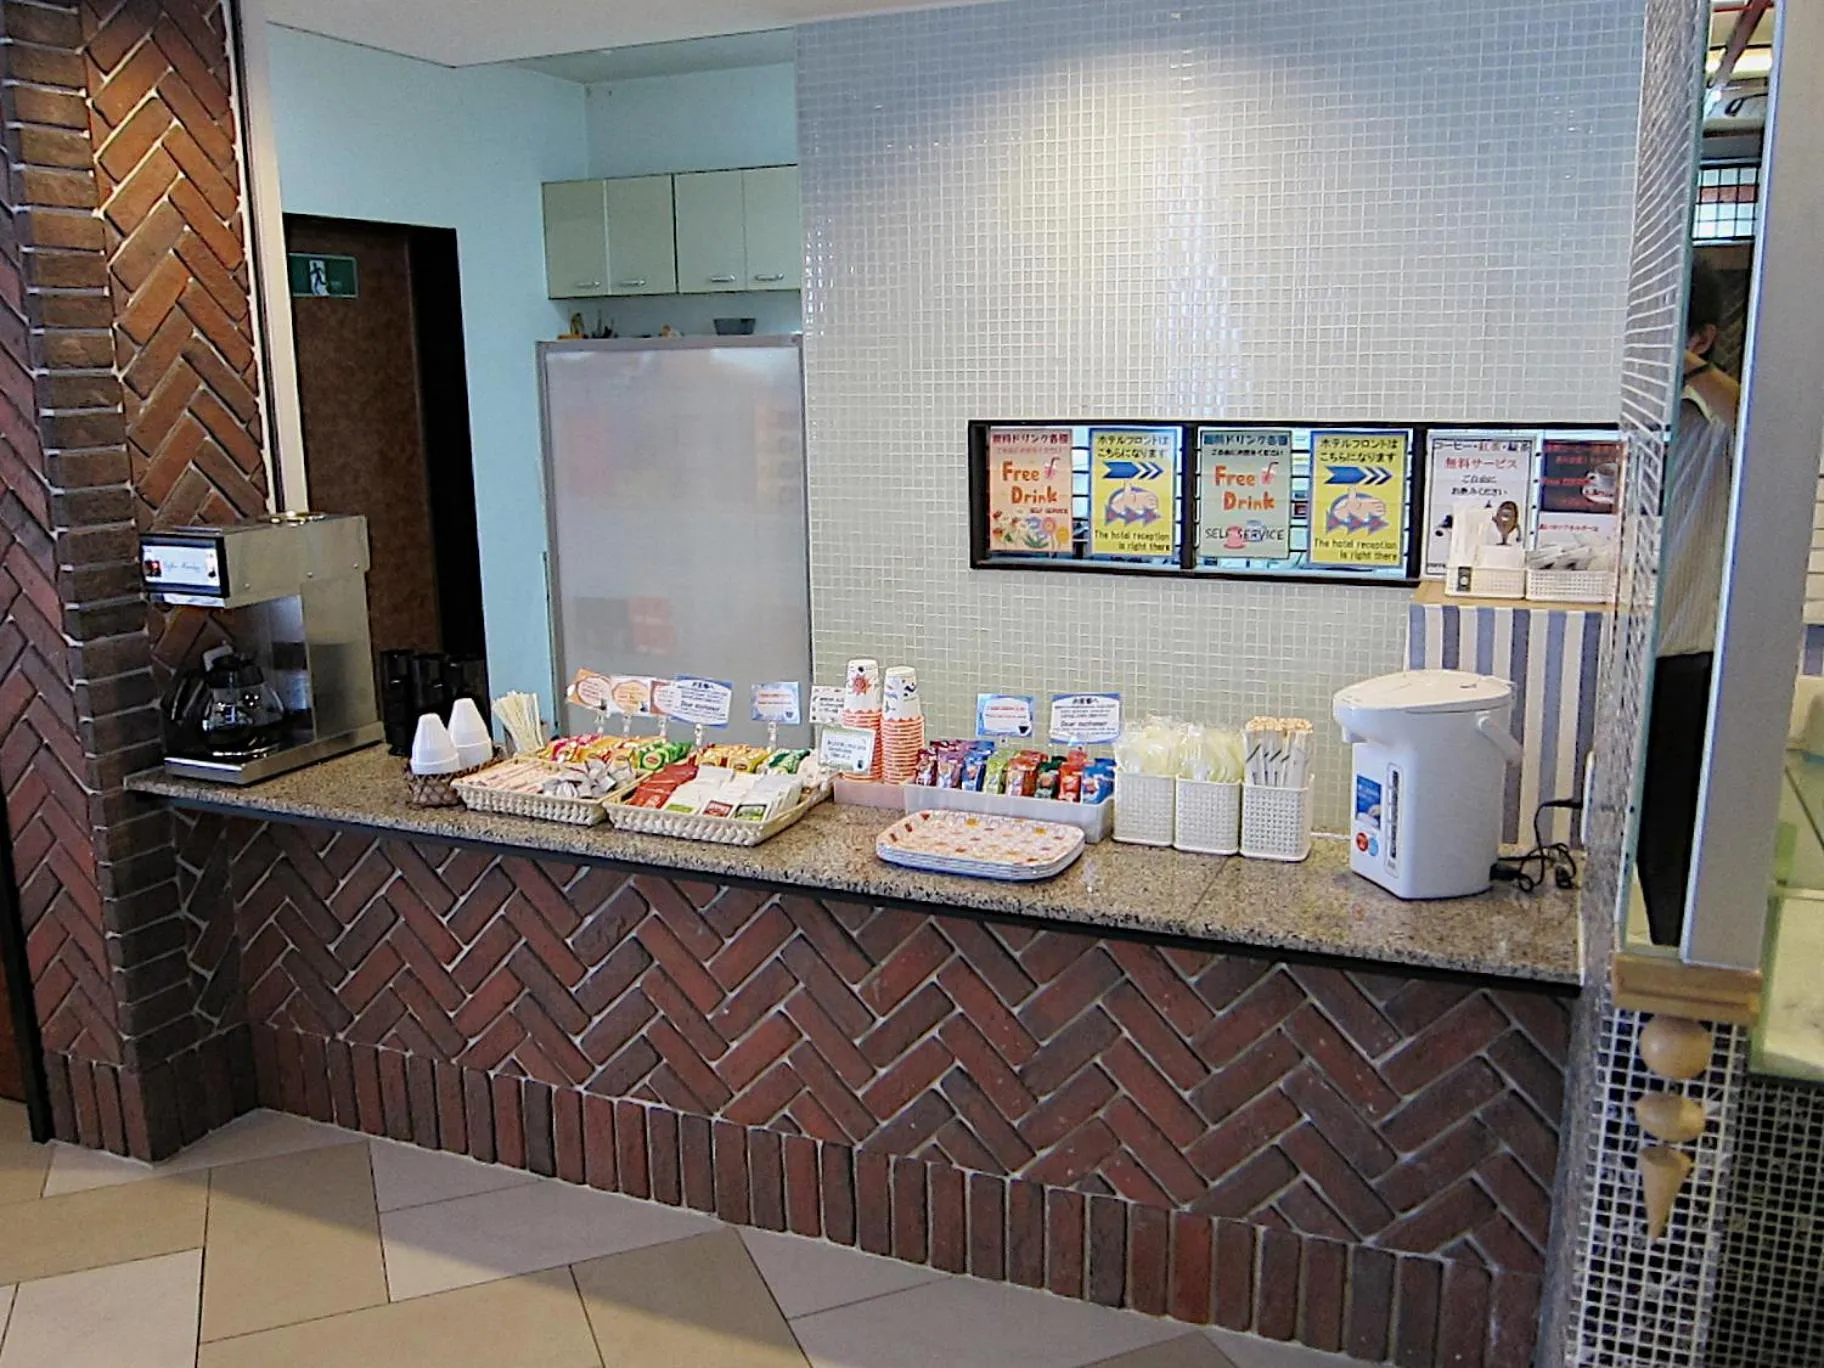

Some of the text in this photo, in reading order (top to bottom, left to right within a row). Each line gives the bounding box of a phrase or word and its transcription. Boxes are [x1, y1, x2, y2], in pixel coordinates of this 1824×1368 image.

[1097, 435, 1169, 445] ホテルフロントは
[1321, 439, 1398, 449] ホテルフロントは
[1097, 448, 1167, 458] こちらになります
[1320, 452, 1396, 462] こちらになります
[1446, 457, 1518, 469] 無料サービス
[1002, 460, 1040, 481] Free
[1215, 465, 1256, 486] Free
[1012, 485, 1057, 504] Drink
[1223, 491, 1275, 511] Drink
[1095, 530, 1169, 542] The hotel reception
[1127, 541, 1146, 551] right
[1149, 542, 1170, 551] there
[1315, 539, 1396, 550] The hotel reception
[1340, 551, 1397, 561] is right there
